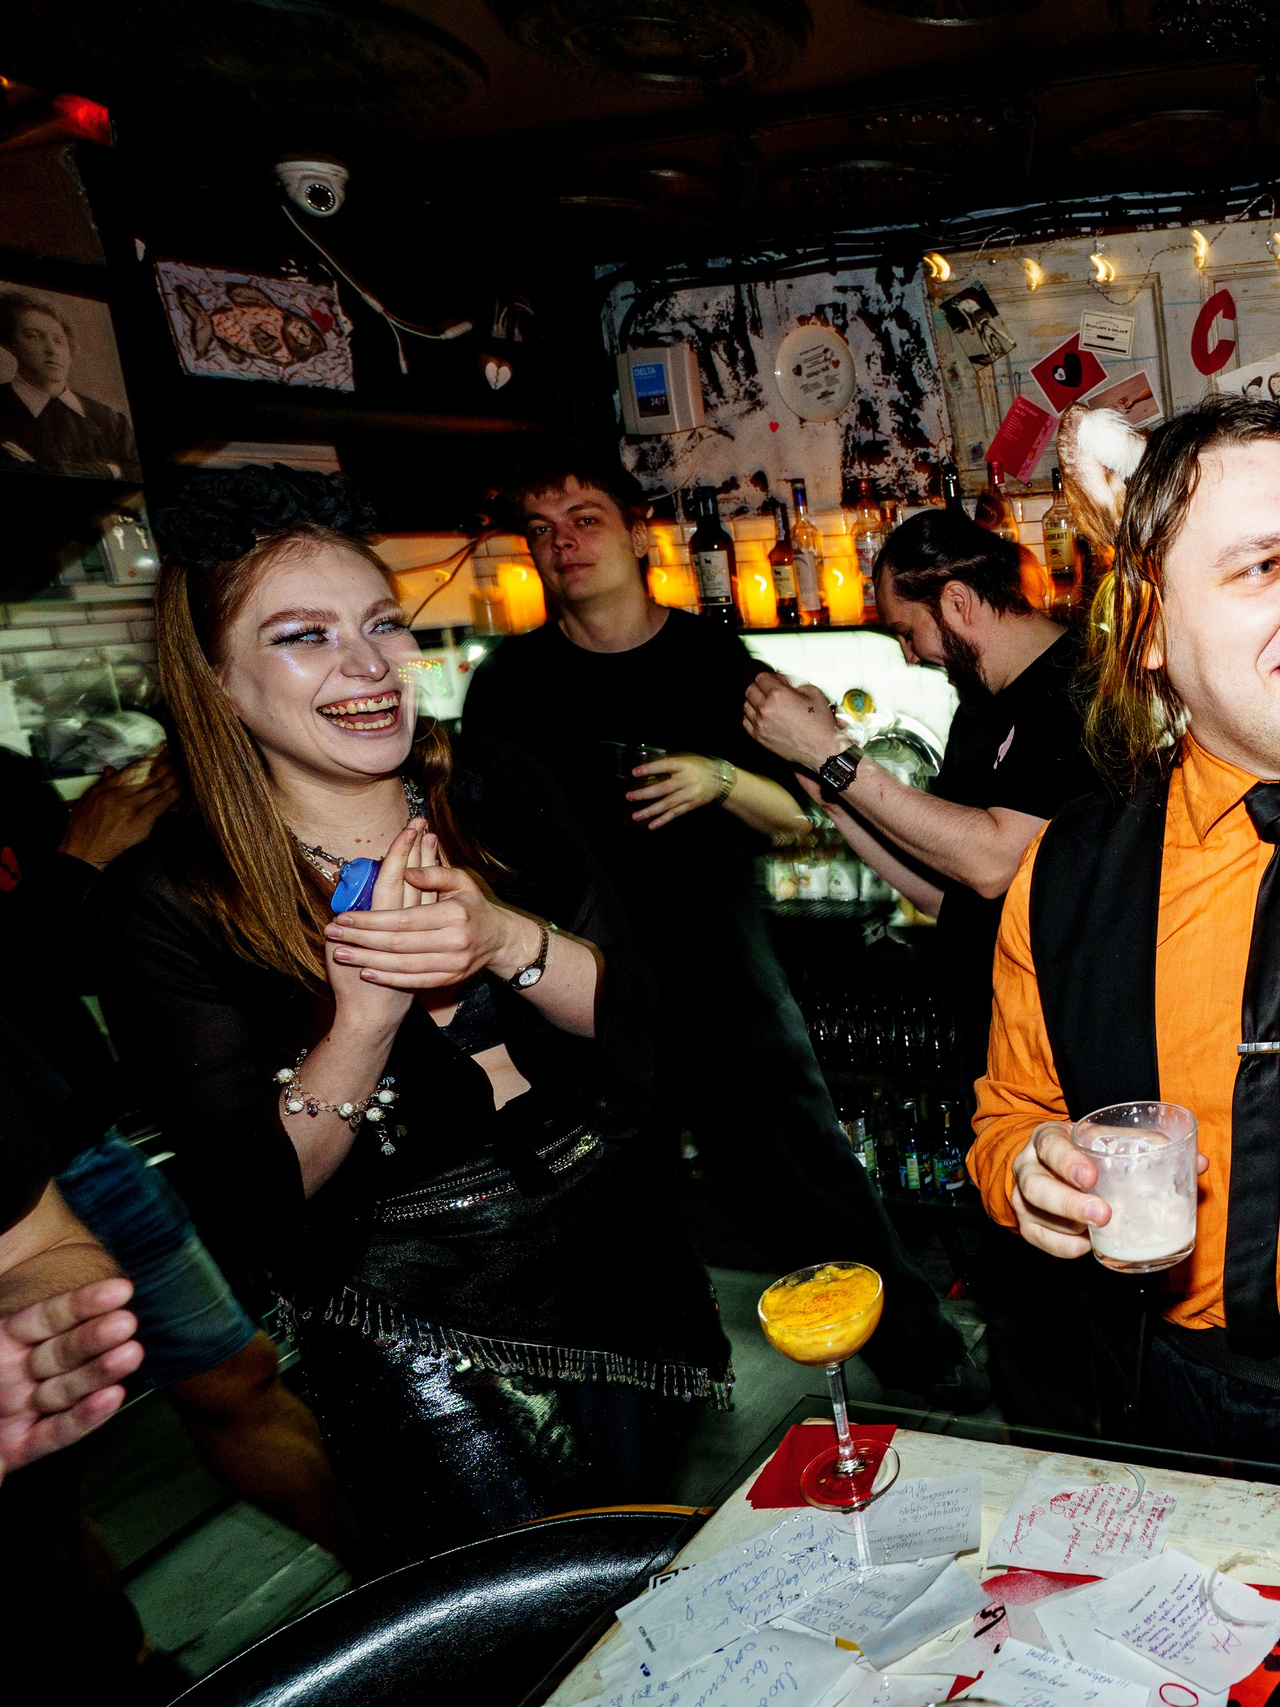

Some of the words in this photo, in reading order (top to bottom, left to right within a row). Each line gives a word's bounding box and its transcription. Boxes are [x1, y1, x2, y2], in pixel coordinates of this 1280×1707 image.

[1190, 288, 1237, 376] С
[634, 367, 656, 376] DELTA
[650, 397, 666, 406] 24/7
